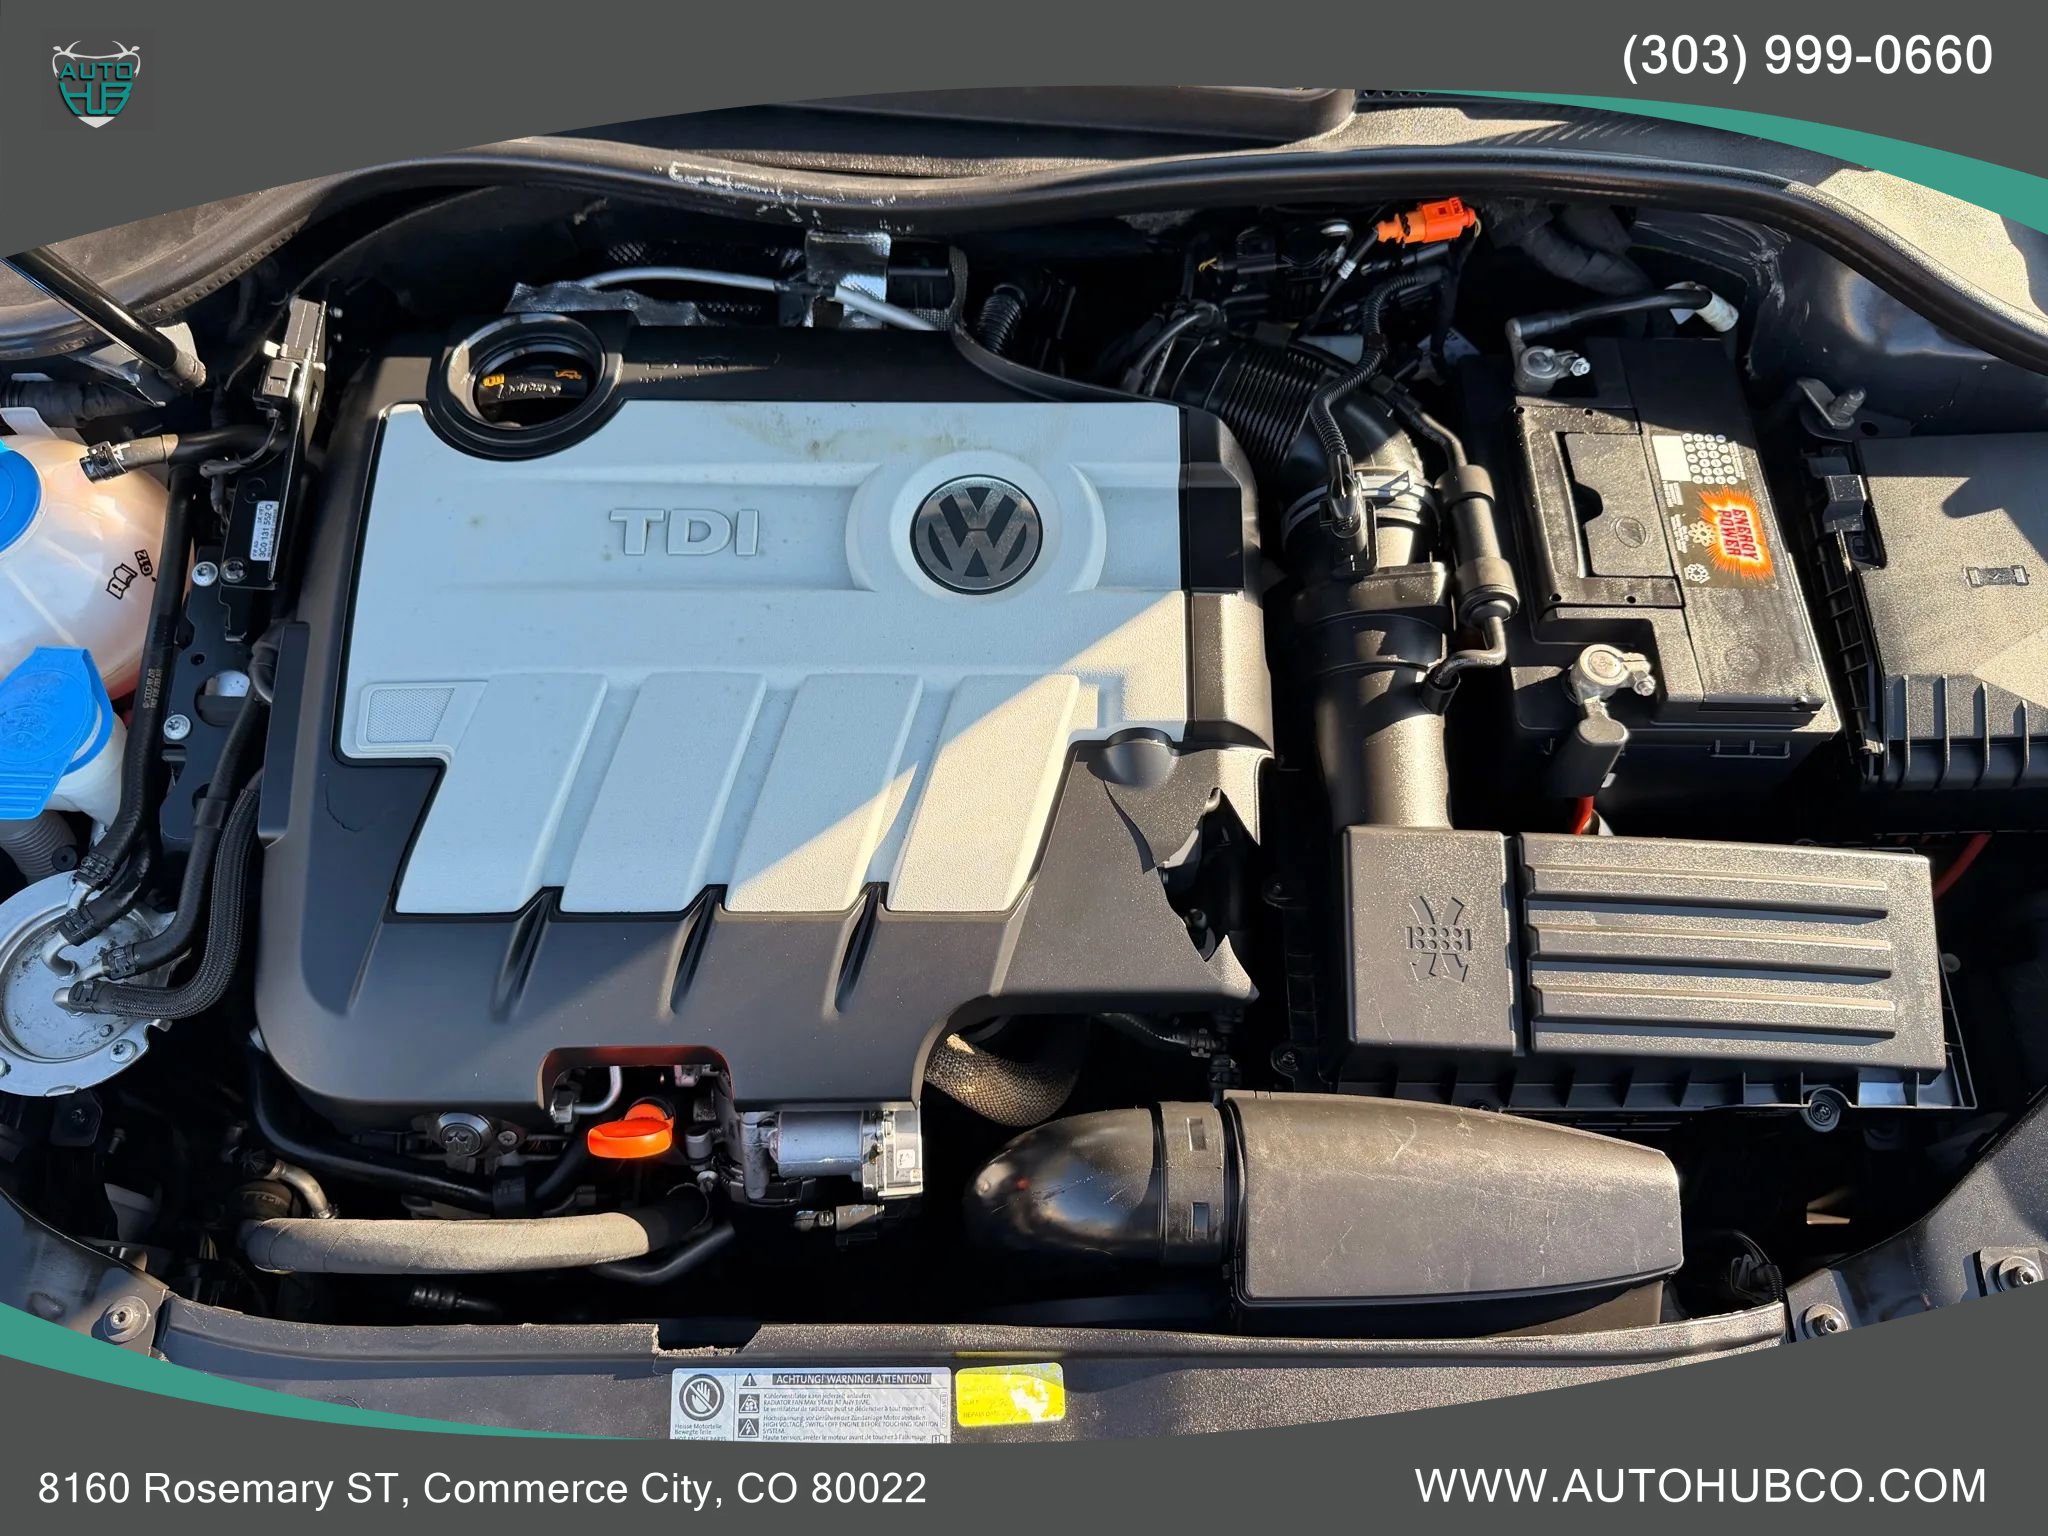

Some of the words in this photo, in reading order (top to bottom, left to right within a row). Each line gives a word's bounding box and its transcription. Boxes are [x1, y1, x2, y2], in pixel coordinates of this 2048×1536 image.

[263, 512, 272, 525] 552
[261, 527, 270, 541] 131
[608, 508, 760, 557] TDI
[1717, 509, 1742, 556] POWER
[136, 550, 152, 575] G12
[776, 1374, 824, 1384] ACHTUNG!
[827, 1374, 874, 1384] WARNING!
[875, 1374, 928, 1384] ATTENTION!
